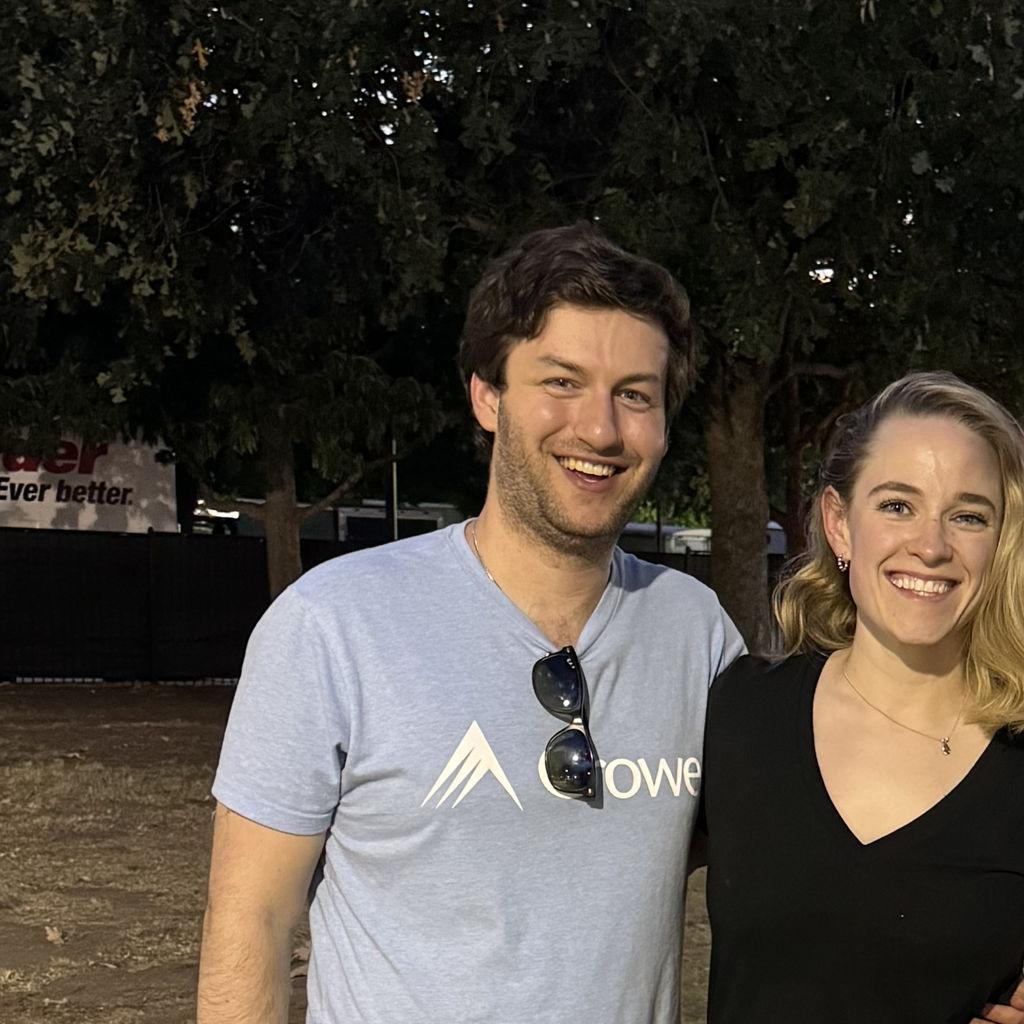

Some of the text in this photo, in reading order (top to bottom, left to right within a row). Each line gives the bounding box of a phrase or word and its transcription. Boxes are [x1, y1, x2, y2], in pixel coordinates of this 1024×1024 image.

[0, 477, 133, 505] Ever better.
[538, 751, 701, 799] owe
